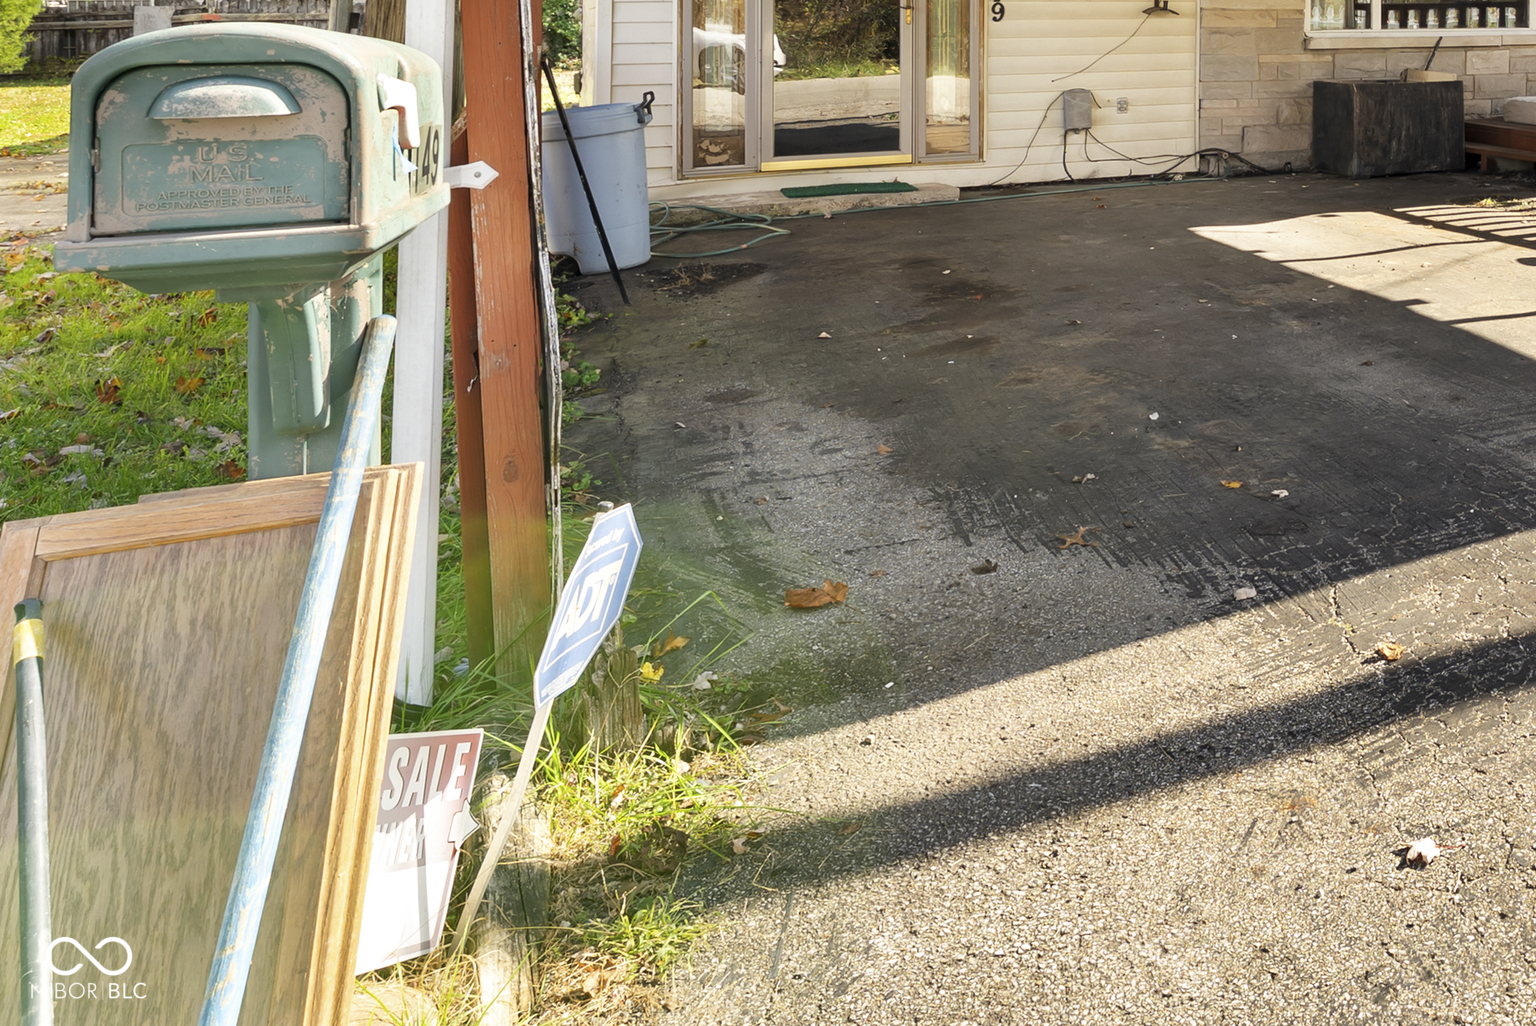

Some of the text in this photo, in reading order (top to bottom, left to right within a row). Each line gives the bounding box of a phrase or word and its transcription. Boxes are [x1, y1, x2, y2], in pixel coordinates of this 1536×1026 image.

[189, 164, 265, 184] MAIL
[158, 185, 294, 200] APPROVED BY THE
[135, 194, 312, 212] POSTMASTER GENERAL
[551, 558, 622, 653] ADT
[380, 741, 472, 811] SALE
